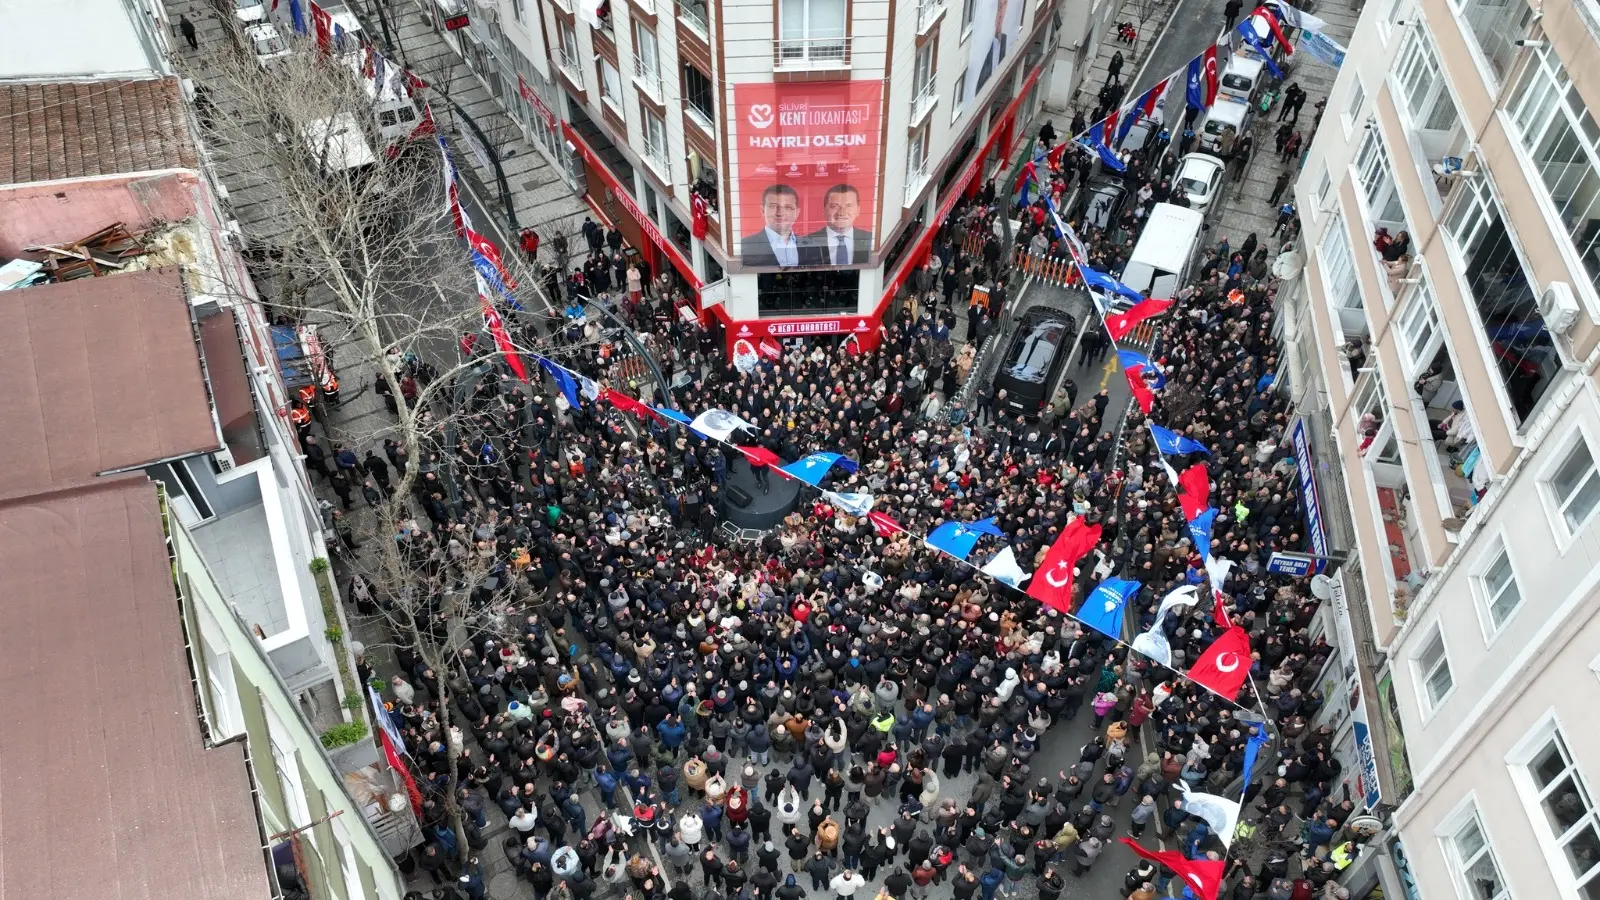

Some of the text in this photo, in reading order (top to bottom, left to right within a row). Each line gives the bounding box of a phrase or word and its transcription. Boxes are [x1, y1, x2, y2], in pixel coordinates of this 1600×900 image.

[780, 109, 862, 126] KENT LOKANTASI
[749, 134, 867, 148] HAYIRLI OLSUN
